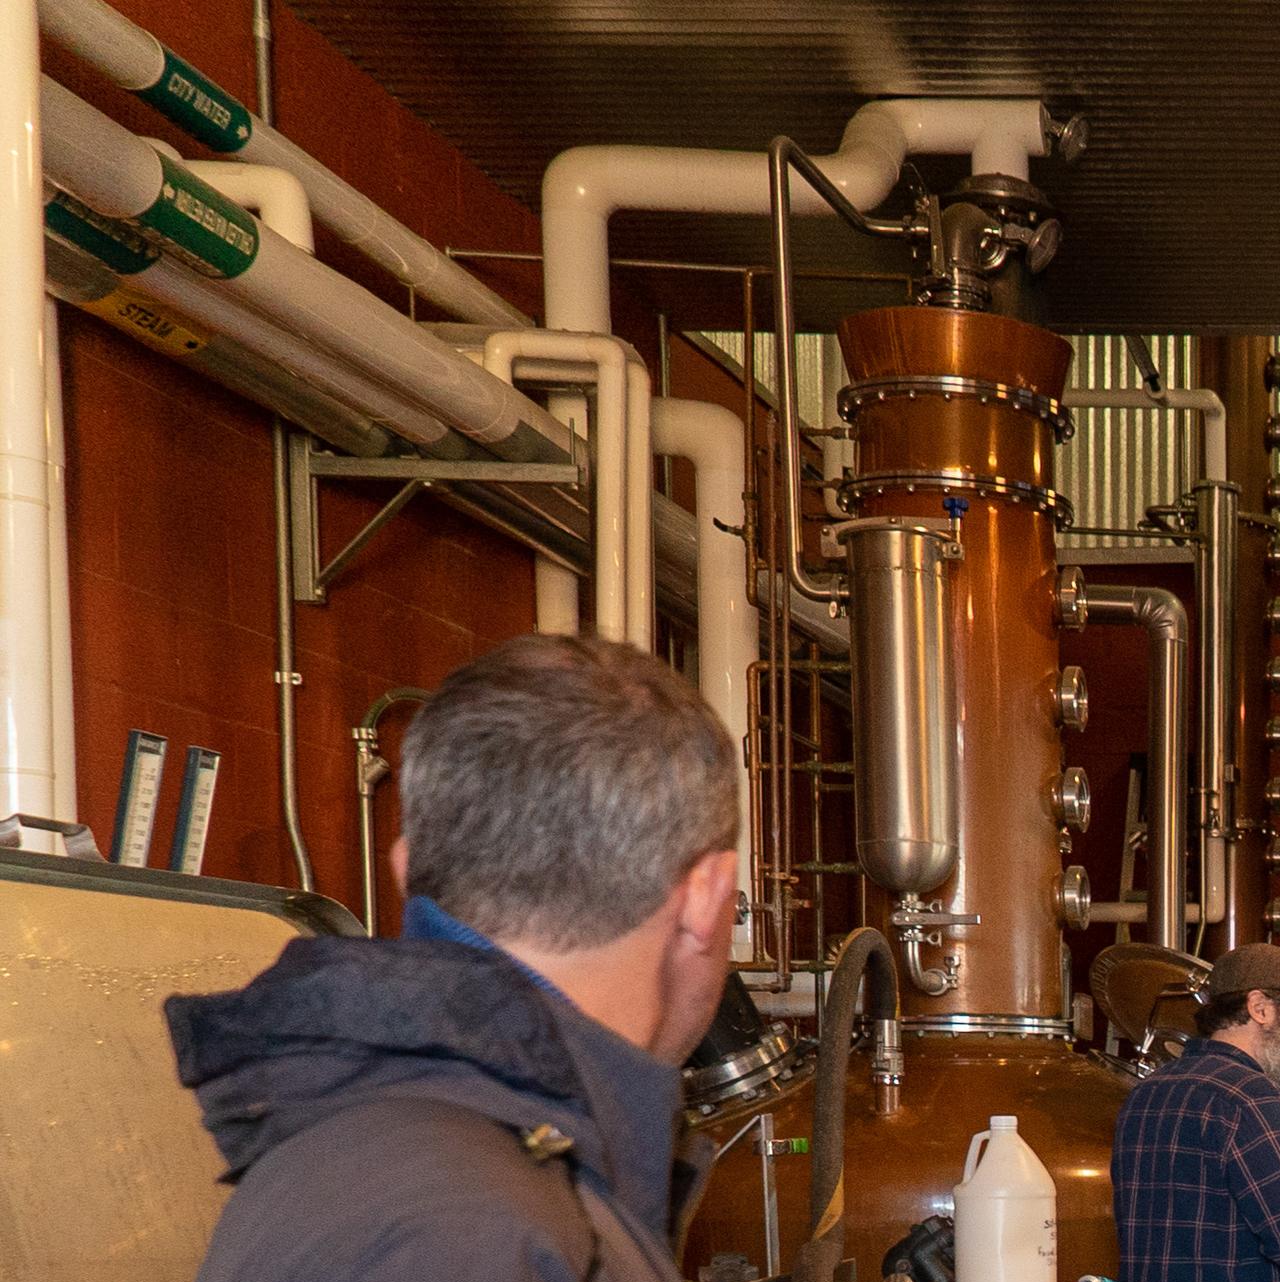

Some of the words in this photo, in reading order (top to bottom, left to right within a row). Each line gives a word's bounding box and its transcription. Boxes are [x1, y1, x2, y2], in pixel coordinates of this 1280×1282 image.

[166, 73, 194, 102] CITY
[192, 89, 231, 131] WATER
[118, 303, 173, 338] STEAM
